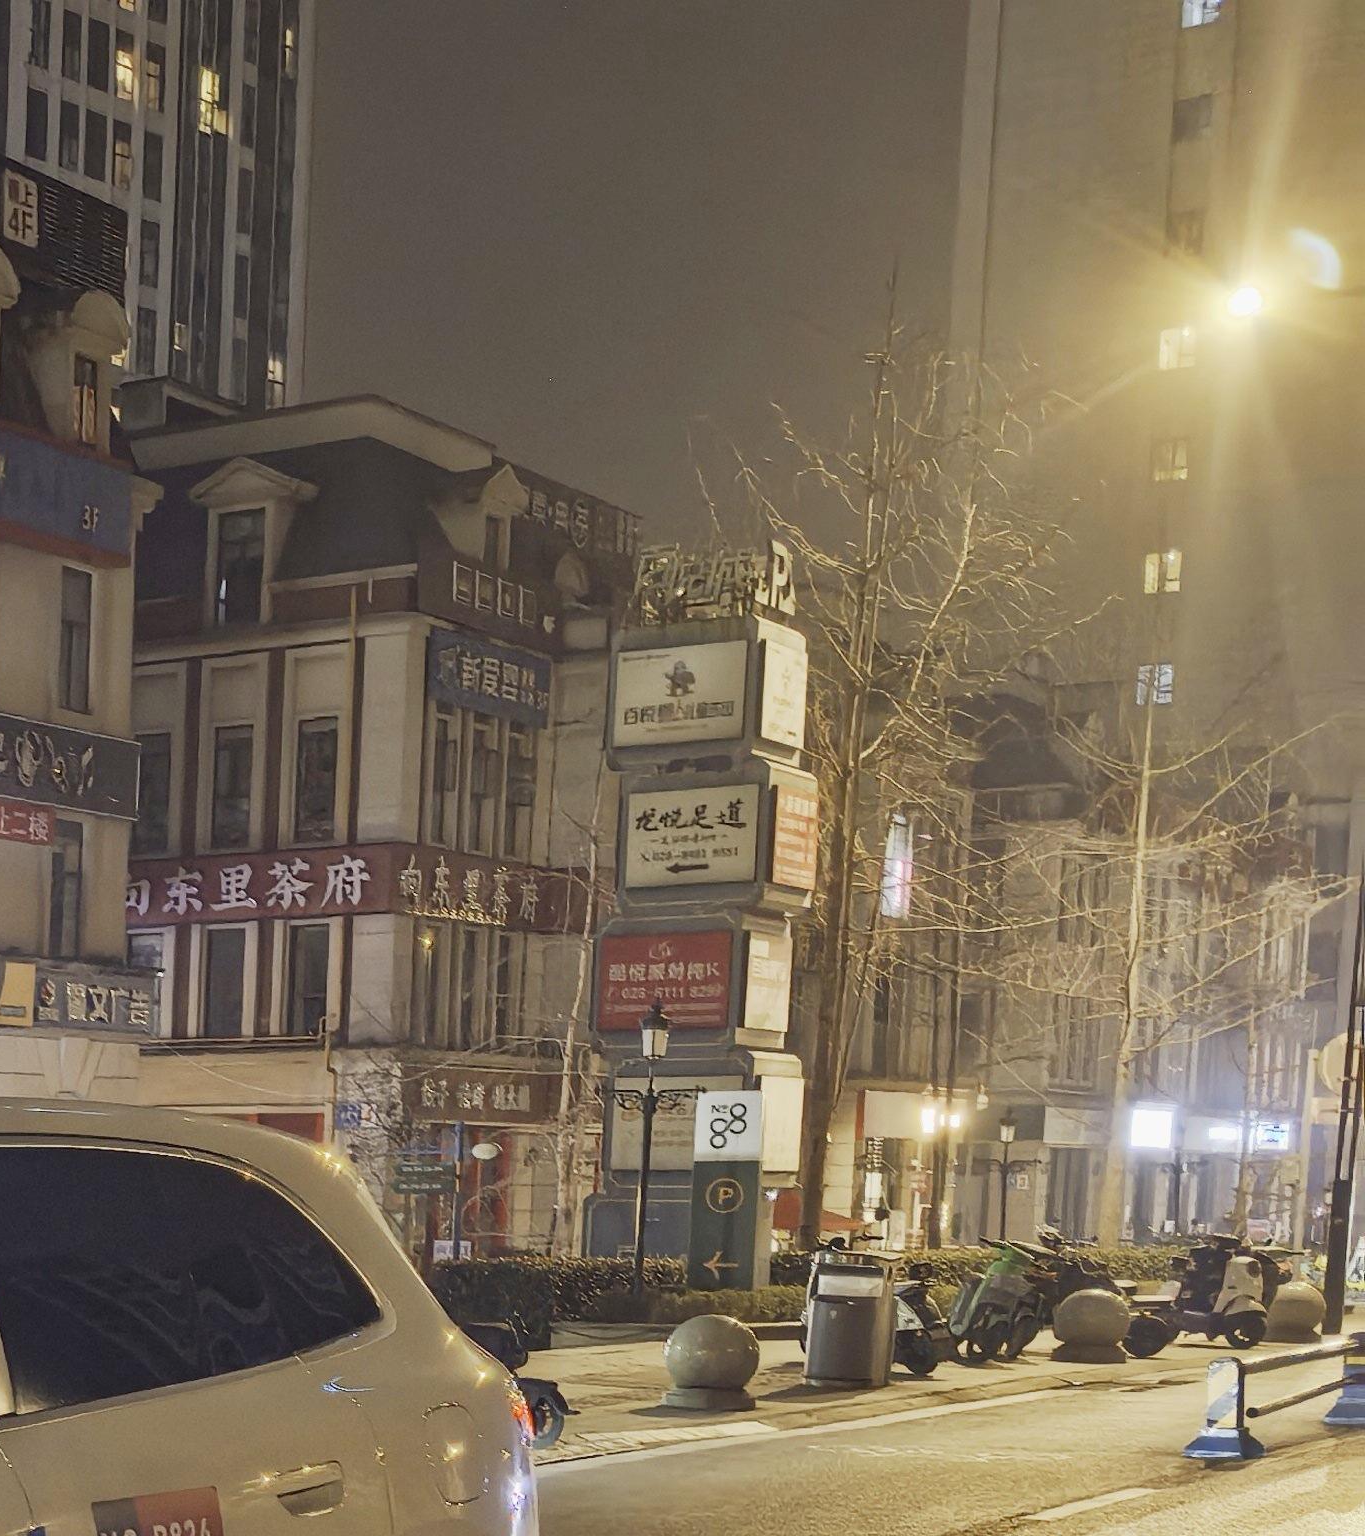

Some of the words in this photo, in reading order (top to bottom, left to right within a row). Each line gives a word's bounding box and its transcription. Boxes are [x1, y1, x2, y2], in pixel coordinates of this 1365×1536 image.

[126, 855, 371, 916] 向东里茶府
